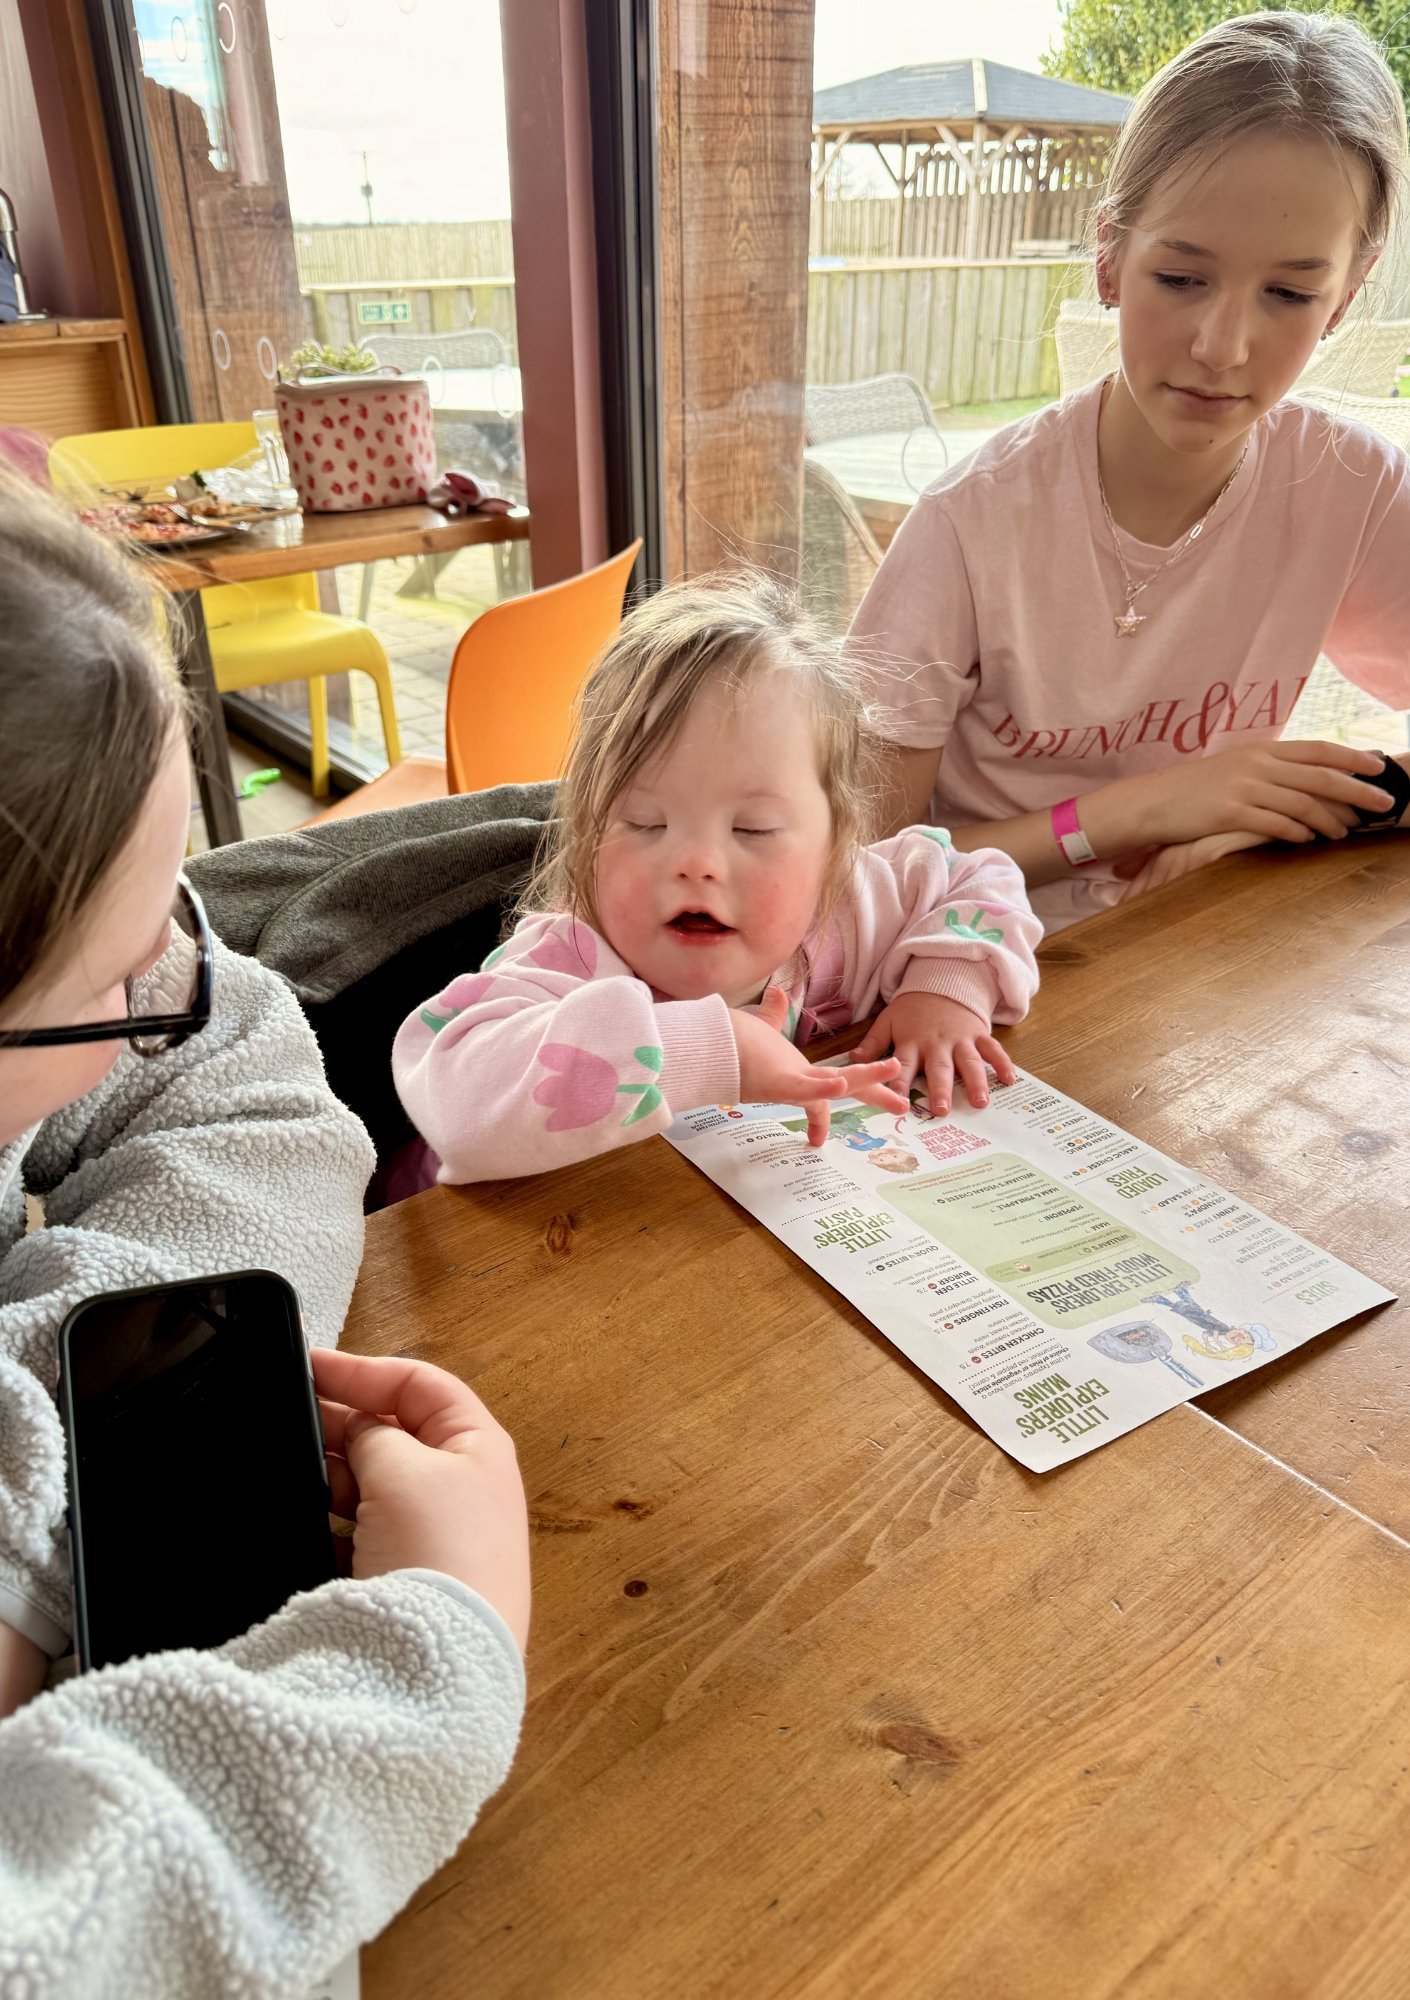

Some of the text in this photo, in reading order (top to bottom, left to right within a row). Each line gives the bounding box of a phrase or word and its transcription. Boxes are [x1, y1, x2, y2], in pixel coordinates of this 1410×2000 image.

[1028, 1095, 1054, 1106] CHEESE
[1034, 1098, 1061, 1110] BACON
[695, 1108, 717, 1116] GLUTEN
[707, 1119, 728, 1127] GLUTEN
[1061, 1115, 1087, 1127] CHEESY
[755, 1131, 789, 1140] TOMATO
[914, 1123, 957, 1140] PARLOUR!
[921, 1129, 967, 1146] ICE CREAM
[1082, 1127, 1109, 1140] CHEESE
[1090, 1131, 1116, 1144] VEGAN
[925, 1133, 981, 1153] TO VISIT OUR
[932, 1138, 991, 1160] DON'T FORGET
[1065, 1141, 1092, 1154] GARLIC
[790, 1153, 817, 1162] CHEESE
[1111, 1145, 1138, 1158] GARLIC
[1086, 1156, 1114, 1169] CHEESE
[997, 1172, 1036, 1186] WILLIAM'S
[1105, 1165, 1147, 1187] FRIES
[971, 1184, 999, 1194] VEGAN
[1039, 1186, 1059, 1195] HAM
[1116, 1172, 1168, 1199] LOADED
[944, 1191, 974, 1202] CHEESE
[996, 1194, 1035, 1210] PINEAPPLE
[1157, 1193, 1182, 1207] SALAD
[1043, 1204, 1083, 1220] PEPPERONI
[1183, 1196, 1225, 1217] GRANDPA'S
[1212, 1204, 1239, 1219] SKINNY
[813, 1206, 864, 1229] PASTA
[1231, 1211, 1253, 1223] FRIES
[813, 1212, 892, 1249] EXPLORERS'
[1089, 1221, 1110, 1230] HAM
[839, 1228, 892, 1253] LITTLE
[1091, 1233, 1128, 1250] WILLIAM'S
[1207, 1227, 1238, 1243] POTATO
[884, 1255, 909, 1267] BITES
[937, 1270, 971, 1285] BURGER
[1026, 1252, 1159, 1303] WOOD-FIRED PIZZAS
[934, 1275, 979, 1295] LITTLE DEN
[1050, 1262, 1173, 1314] LITTLE EXPLORERS'
[981, 1293, 1001, 1303] Freshly
[987, 1298, 1009, 1310] FISH
[957, 1300, 982, 1313] battered
[953, 1306, 990, 1325] FINGERS
[1004, 1311, 1023, 1321] baked
[1007, 1316, 1029, 1327] chicken
[1009, 1321, 1036, 1335] Crumbed
[1004, 1327, 1044, 1348] CHICKEN
[980, 1344, 1007, 1359] BITES
[1027, 1342, 1063, 1360] (cucumber,
[1048, 1346, 1069, 1358] choice
[1016, 1357, 1029, 1366] red
[1028, 1359, 1043, 1368] fries
[1049, 1356, 1064, 1365] Little
[996, 1363, 1018, 1376] pepper
[967, 1376, 990, 1390] carrot)
[990, 1369, 1022, 1386] vegetable
[1002, 1376, 1022, 1388] mains
[971, 1383, 991, 1395] sticks
[986, 1386, 1004, 1396] have
[1013, 1372, 1071, 1409] MAINS
[1016, 1378, 1108, 1437] EXPLORERS'
[1048, 1404, 1109, 1443] LITTLE
